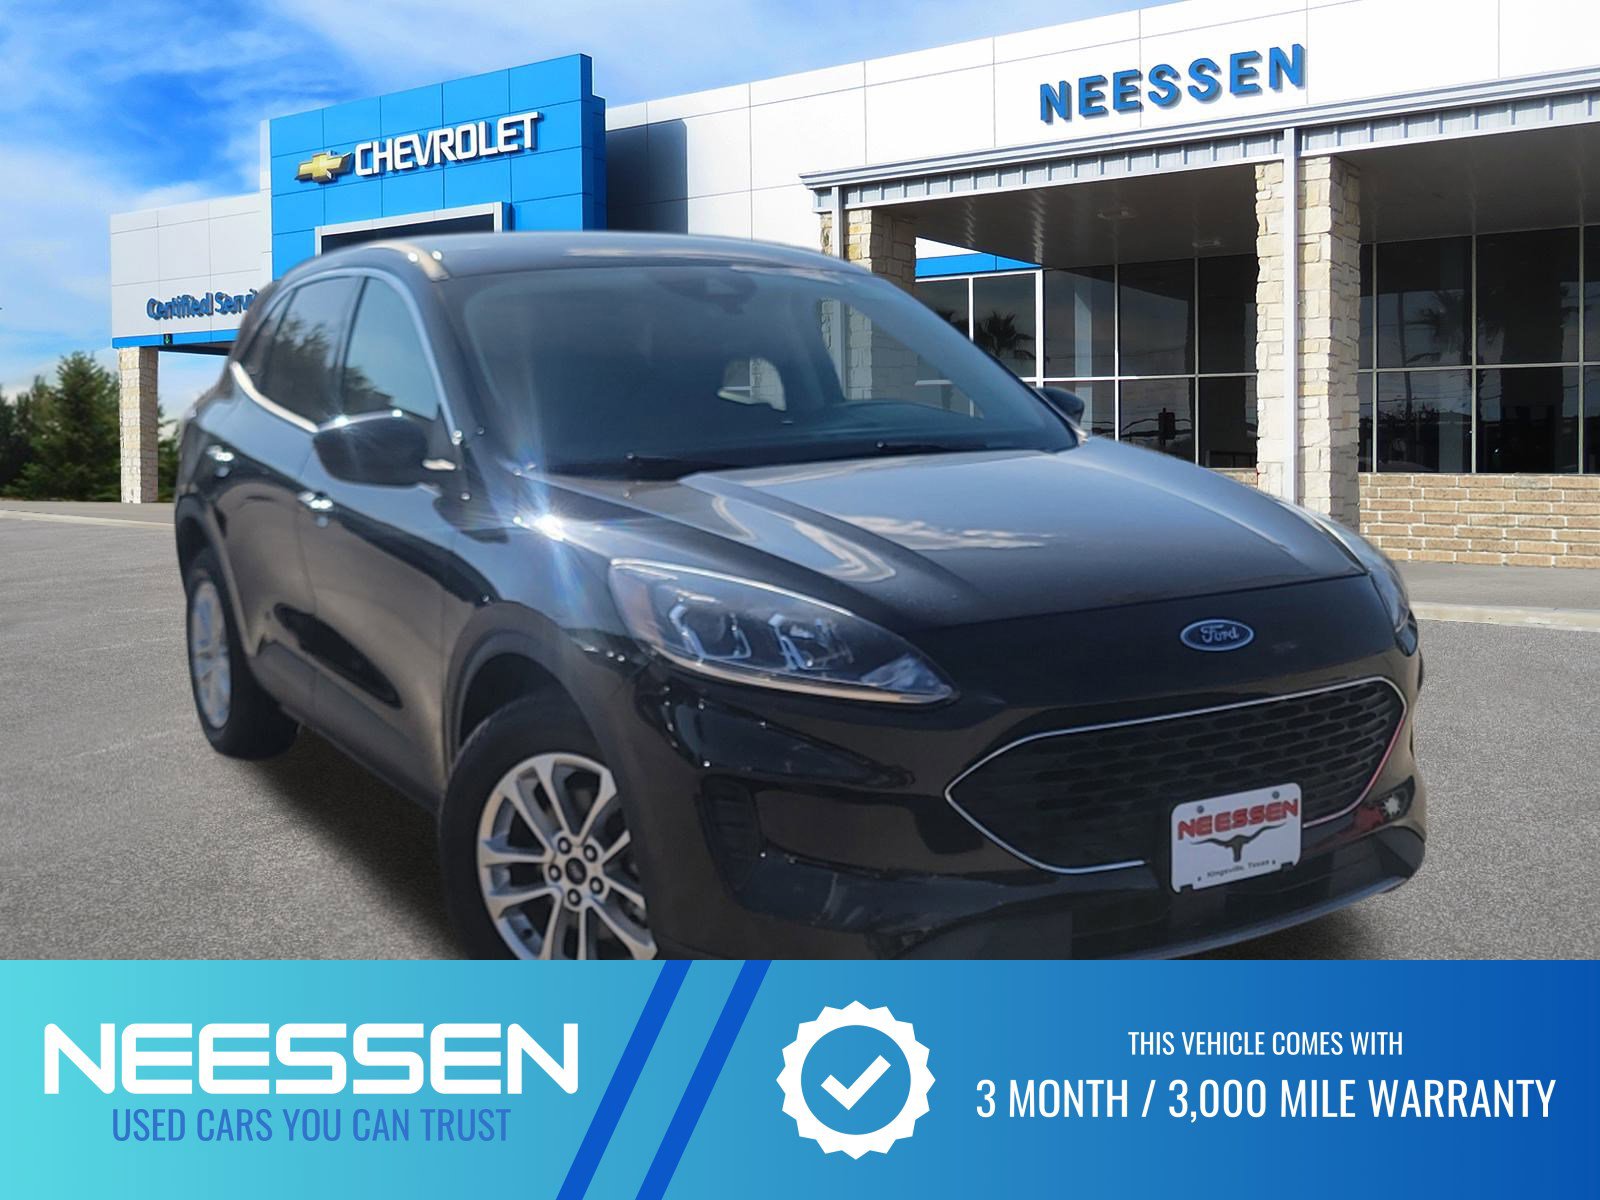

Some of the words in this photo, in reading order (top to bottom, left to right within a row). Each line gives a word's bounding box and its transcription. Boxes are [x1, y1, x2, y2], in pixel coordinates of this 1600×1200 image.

[1039, 43, 1306, 126] NEESSEN
[354, 111, 545, 178] CHEVROLET
[146, 292, 214, 321] Certified
[214, 287, 259, 316] Serv
[1200, 624, 1239, 643] Ford
[1177, 798, 1299, 841] NEESSEN
